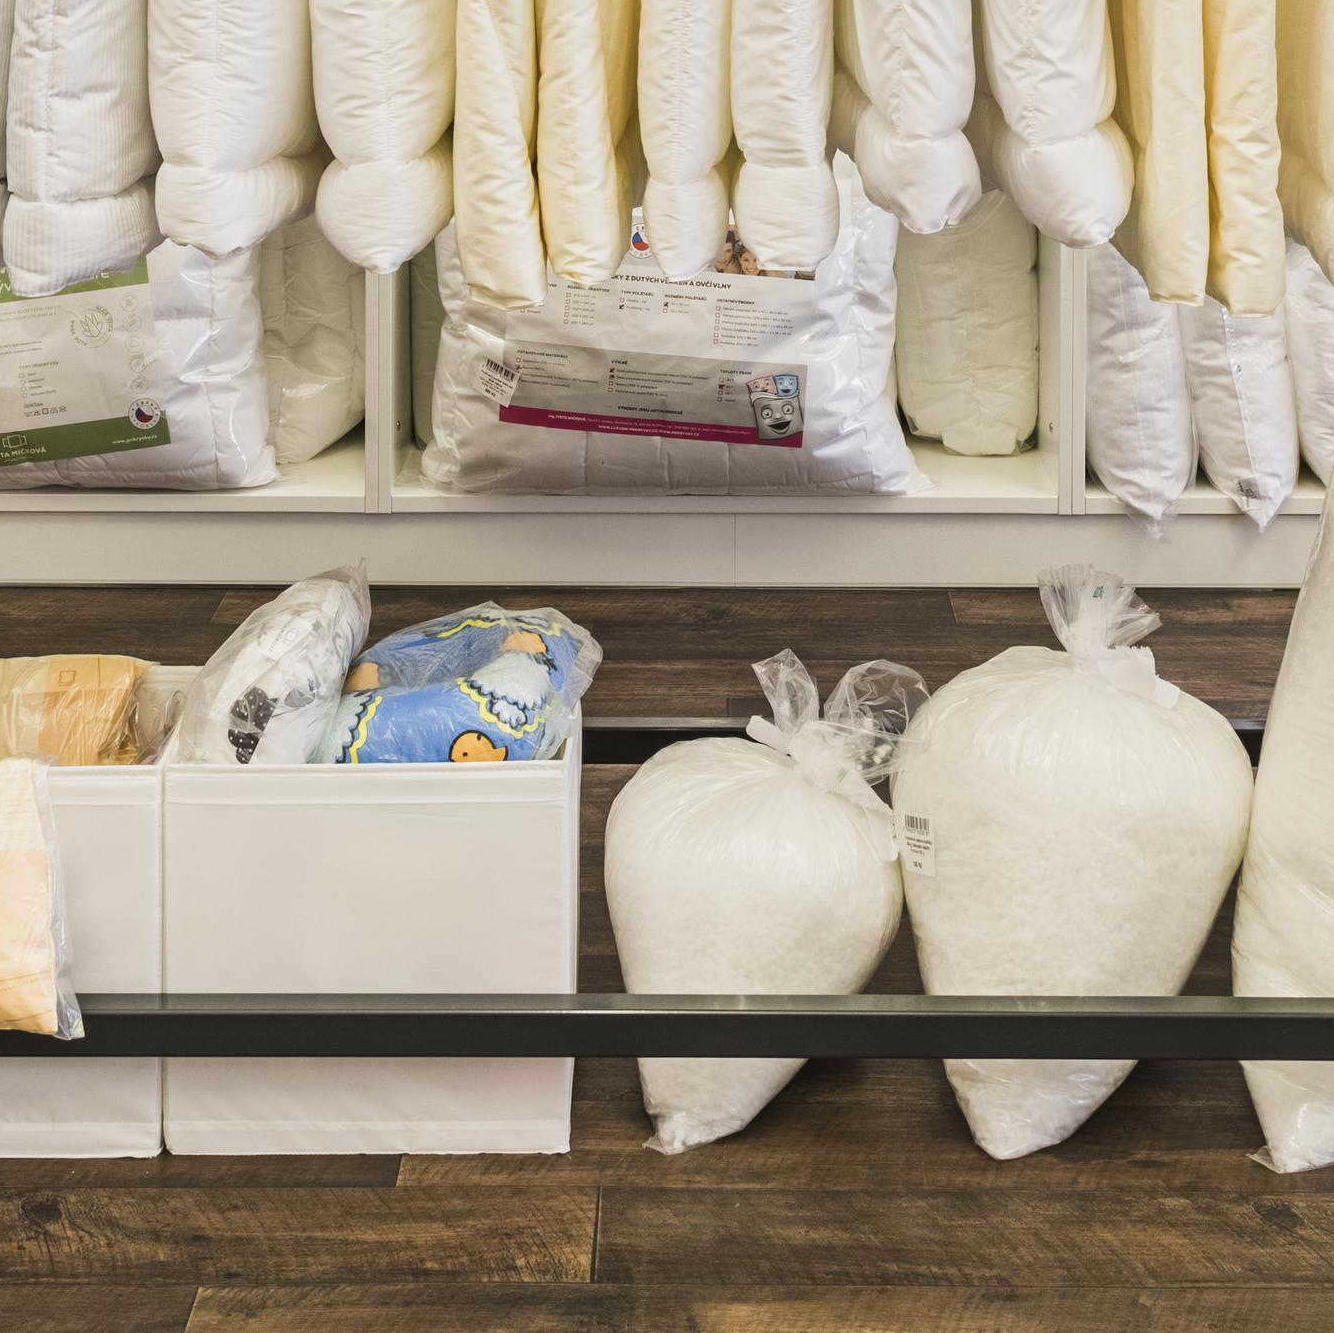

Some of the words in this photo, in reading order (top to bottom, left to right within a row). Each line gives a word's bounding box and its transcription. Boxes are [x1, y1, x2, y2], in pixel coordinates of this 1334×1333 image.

[631, 274, 659, 284] DUTÝCH
[695, 279, 713, 288] OVČÍ
[11, 445, 48, 457] MIČKOVÁ
